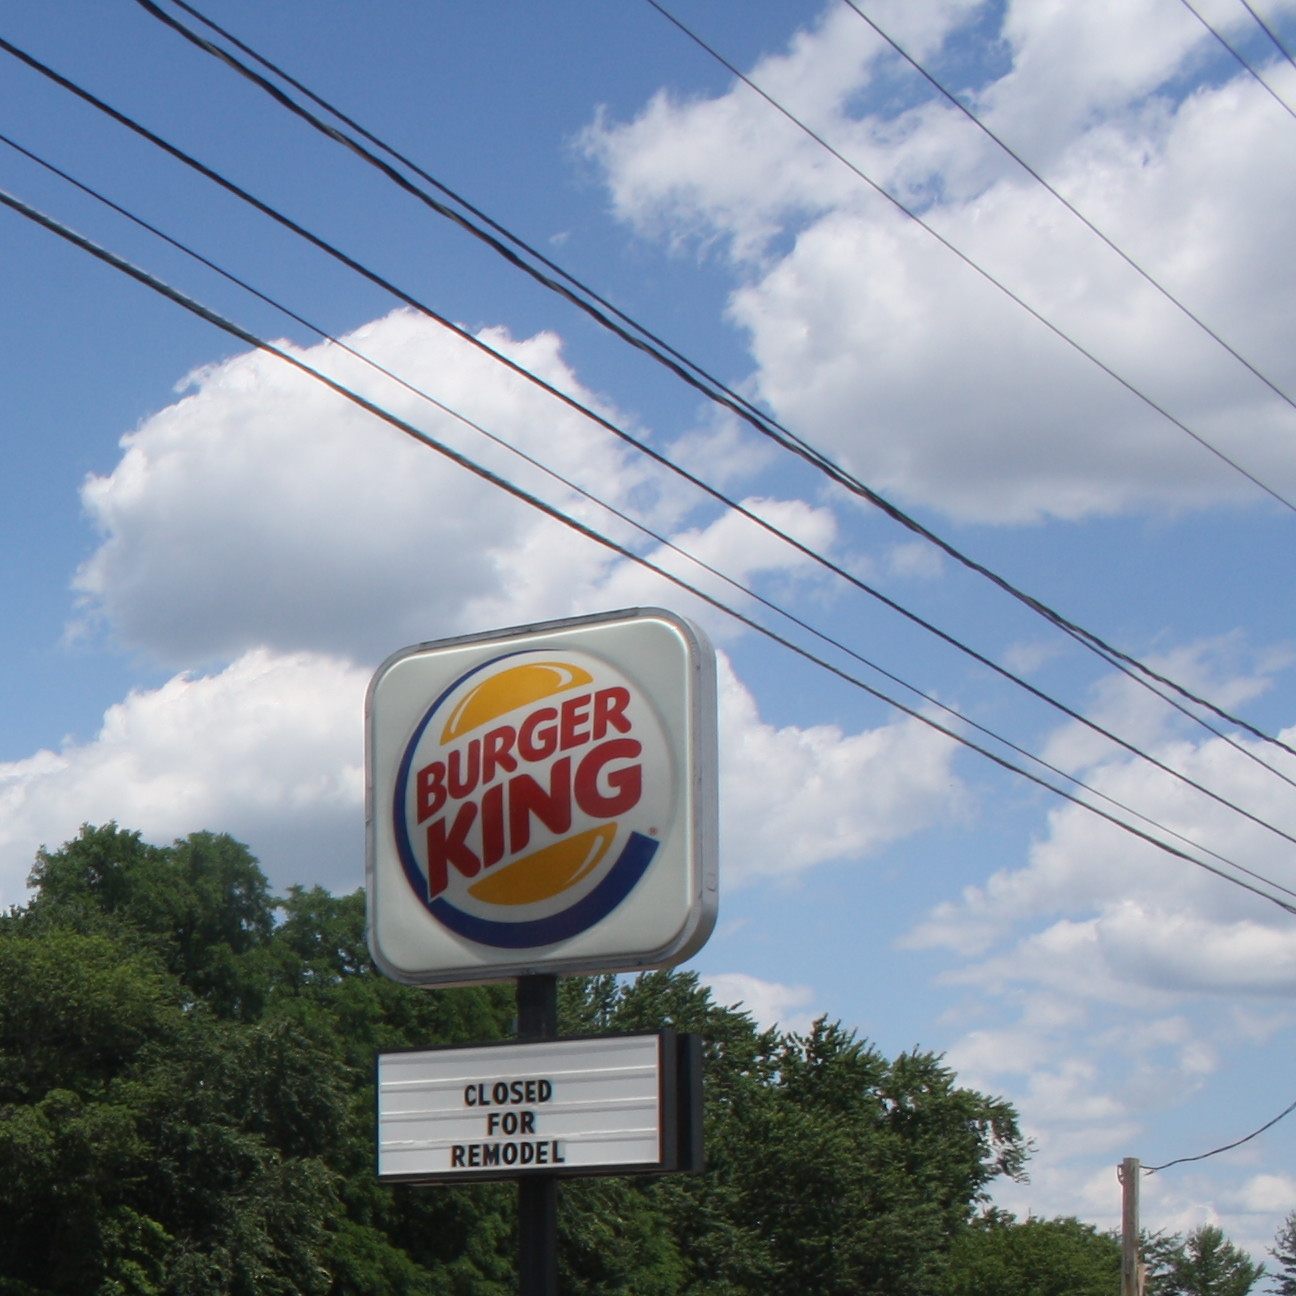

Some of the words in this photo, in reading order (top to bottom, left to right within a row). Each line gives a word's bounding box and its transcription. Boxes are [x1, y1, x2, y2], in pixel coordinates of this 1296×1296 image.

[416, 685, 633, 826] BURGER
[426, 738, 643, 900] KING
[464, 1079, 552, 1107] CLOSED
[487, 1111, 536, 1136] FOR
[451, 1140, 566, 1168] REMODEL
